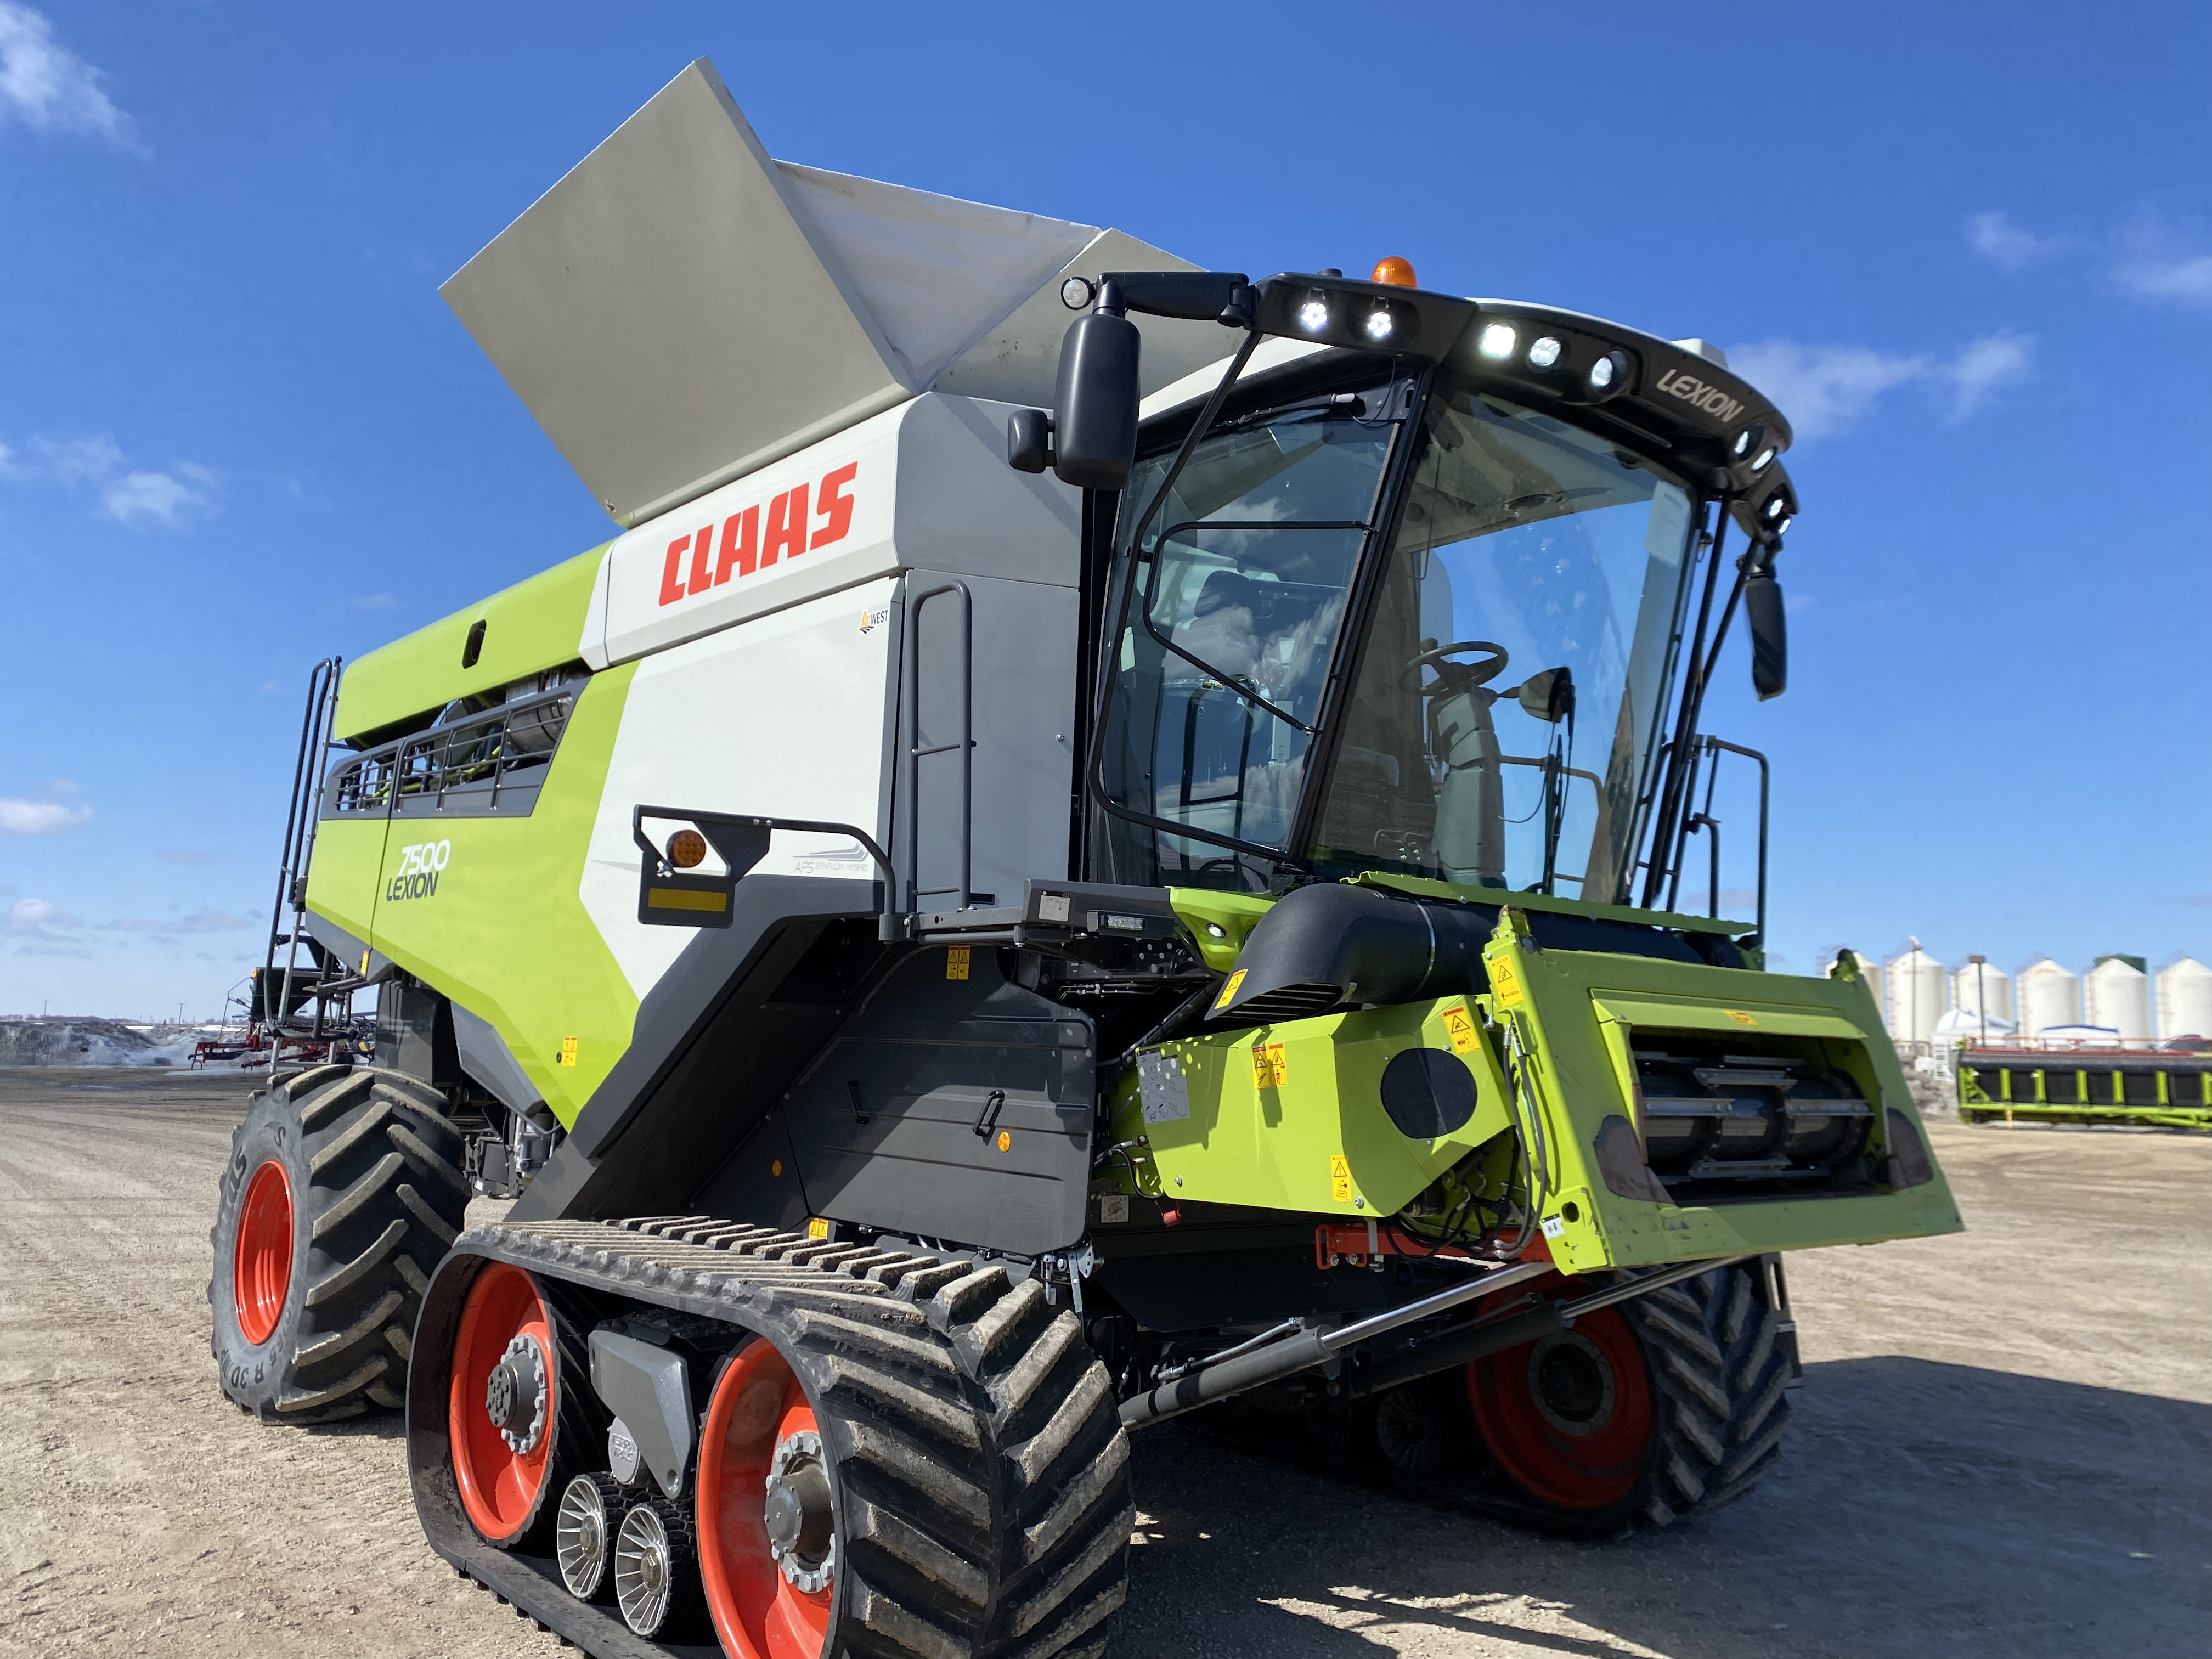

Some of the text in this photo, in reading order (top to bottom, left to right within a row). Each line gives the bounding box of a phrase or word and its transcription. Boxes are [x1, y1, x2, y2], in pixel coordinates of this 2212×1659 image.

[1657, 368, 1745, 422] LEXION
[658, 460, 859, 607] CLAAS
[398, 839, 450, 877] 7500
[793, 861, 815, 873] APS
[845, 864, 869, 872] HYBRID
[386, 871, 439, 901] LEXION
